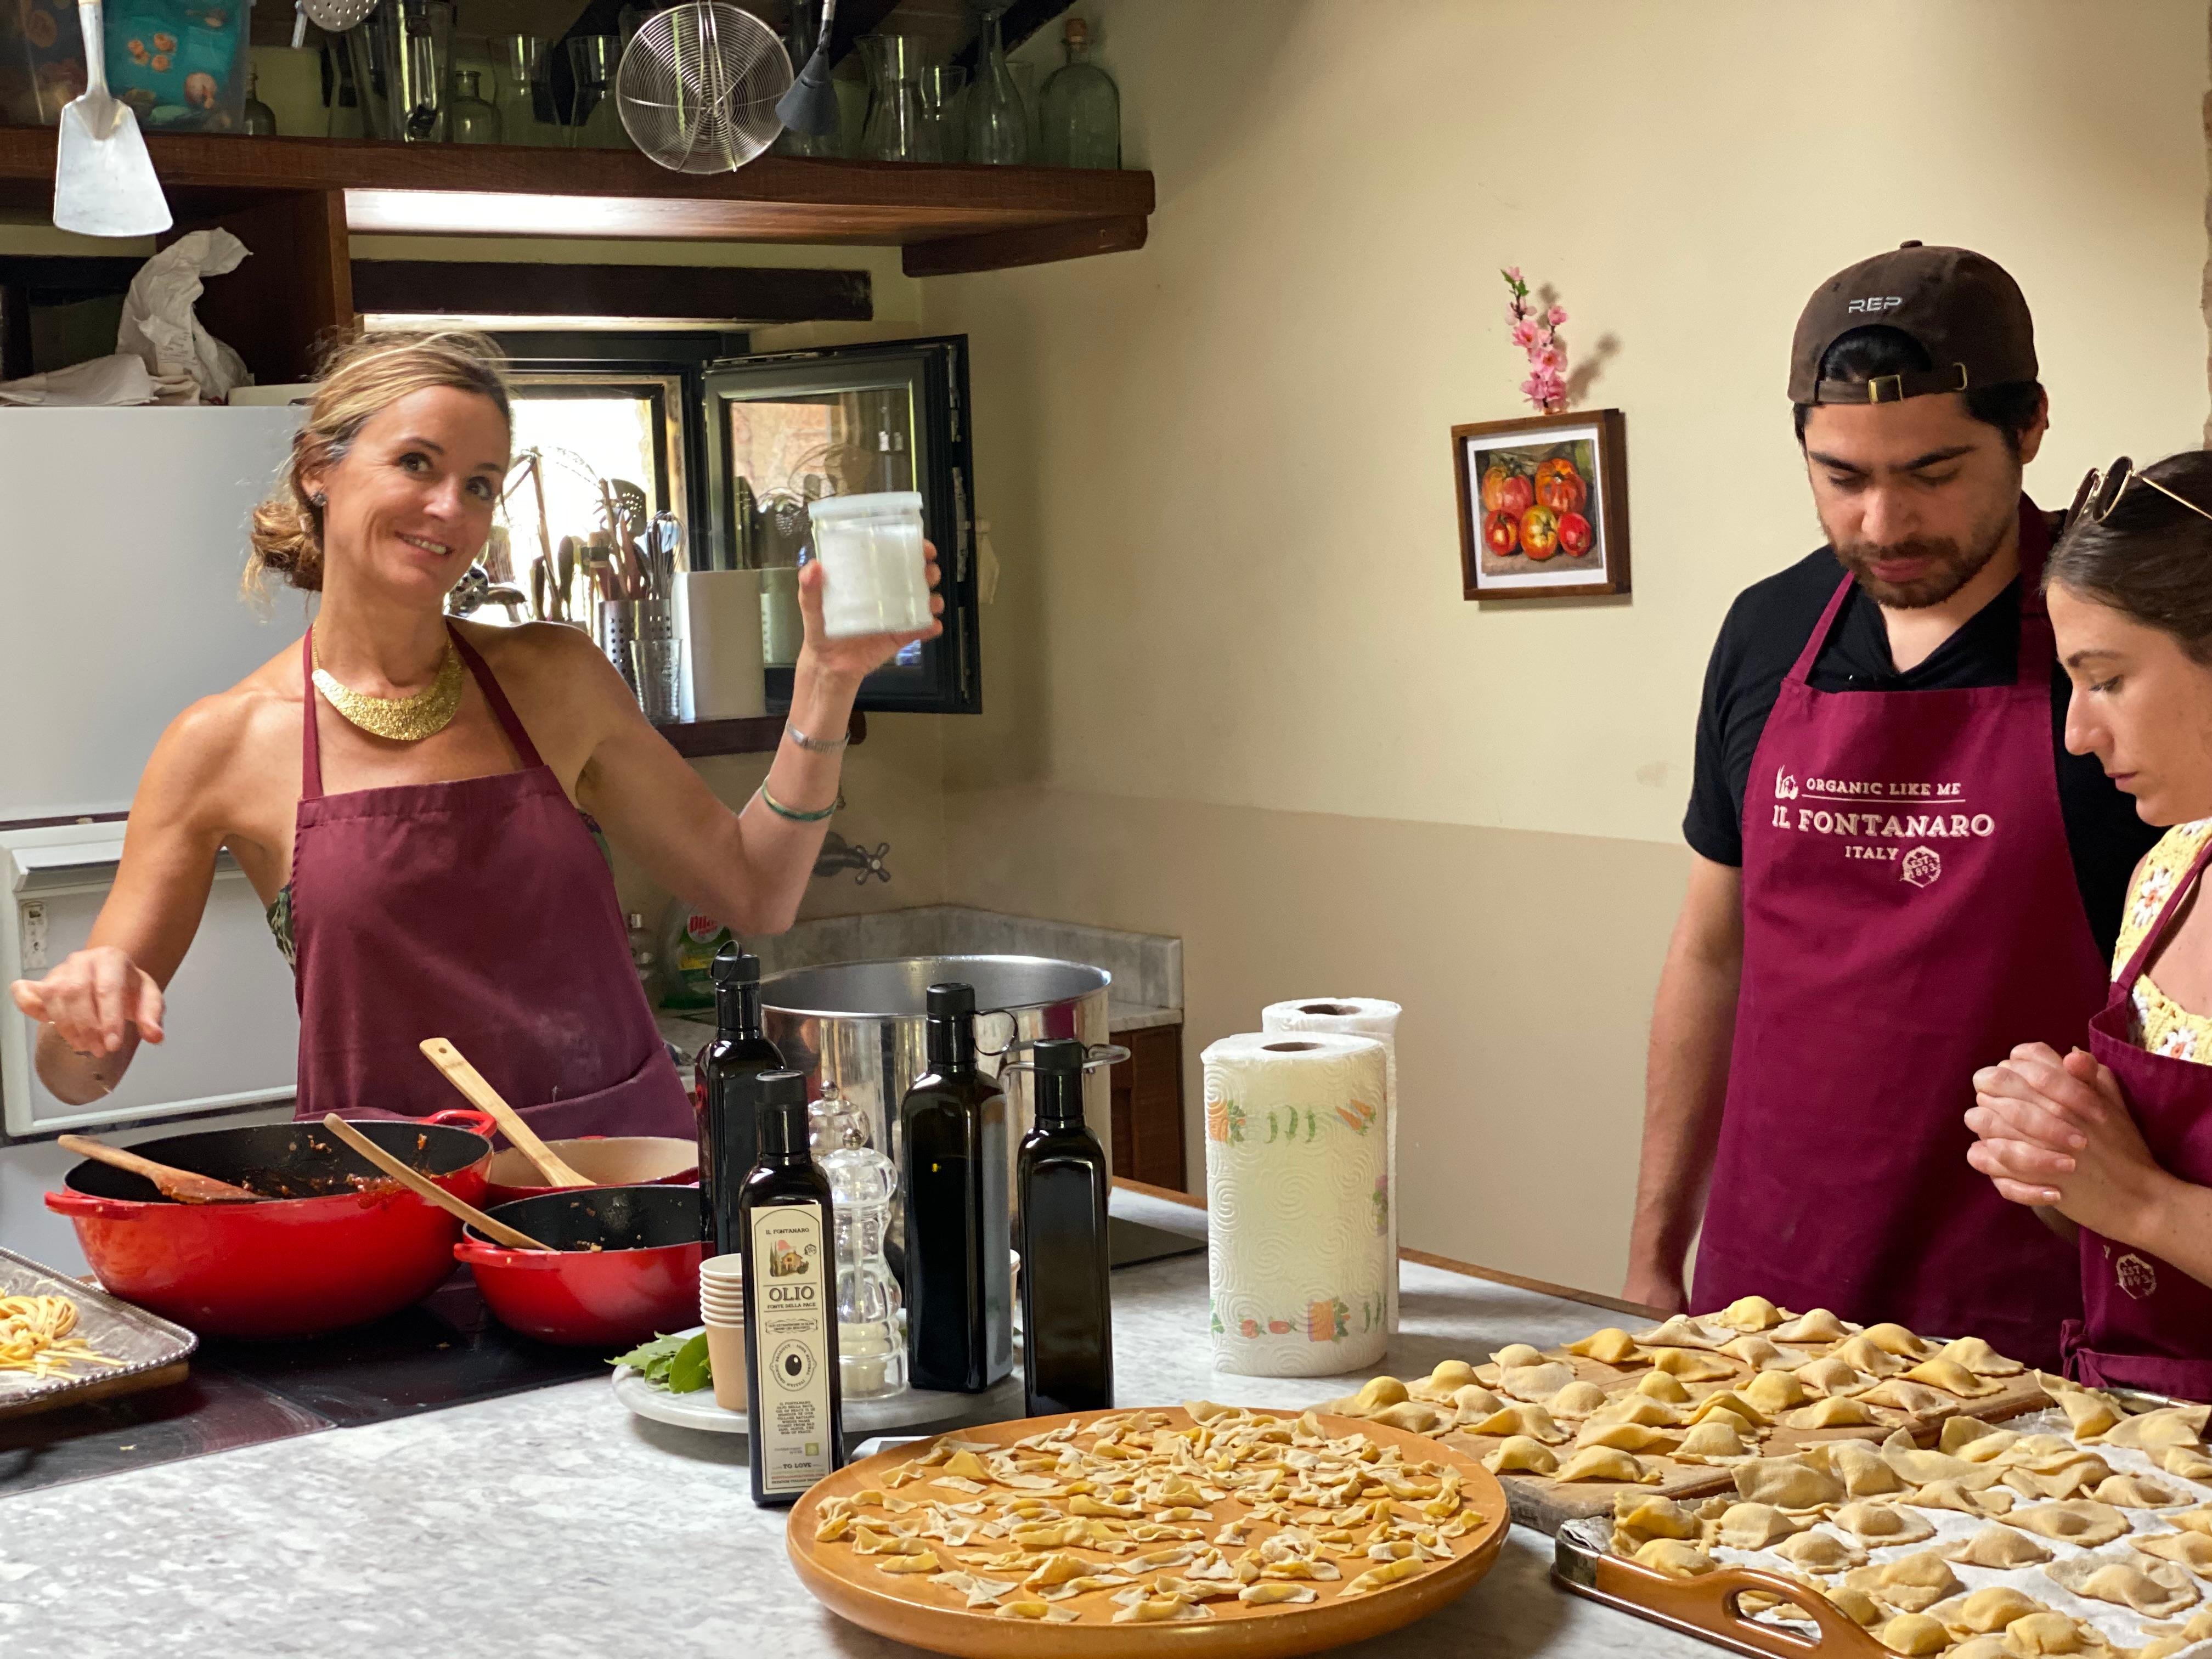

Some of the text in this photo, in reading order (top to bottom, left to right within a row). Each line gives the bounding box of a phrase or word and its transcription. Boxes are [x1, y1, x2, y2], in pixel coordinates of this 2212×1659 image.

[1848, 296, 1903, 313] REP
[1806, 777, 1961, 795] ORGANIC LIKE ME
[1772, 805, 1995, 837] IL FONTANARO
[1845, 846, 1899, 860] ITALY
[769, 1286, 815, 1301] OLIO
